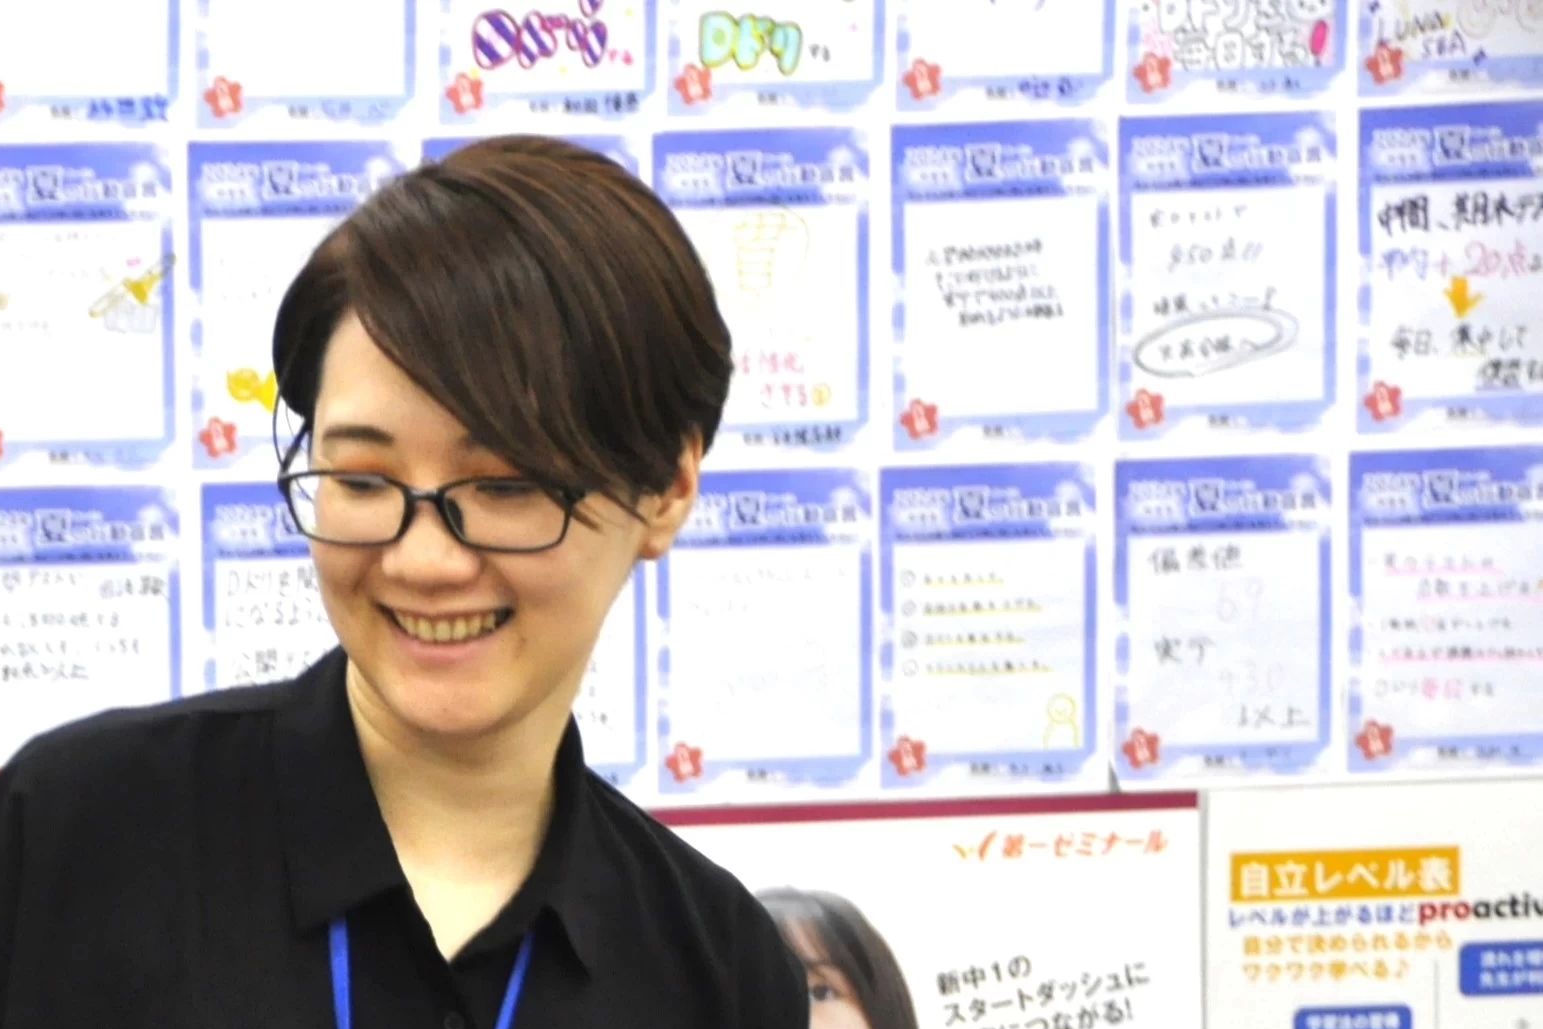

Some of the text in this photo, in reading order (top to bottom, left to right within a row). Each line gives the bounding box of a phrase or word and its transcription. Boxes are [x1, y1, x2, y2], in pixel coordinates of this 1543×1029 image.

[1240, 857, 1453, 900] 自立レベル表
[936, 955, 1032, 997] 新中1の
[942, 962, 1151, 1027] スタートダッシュに
